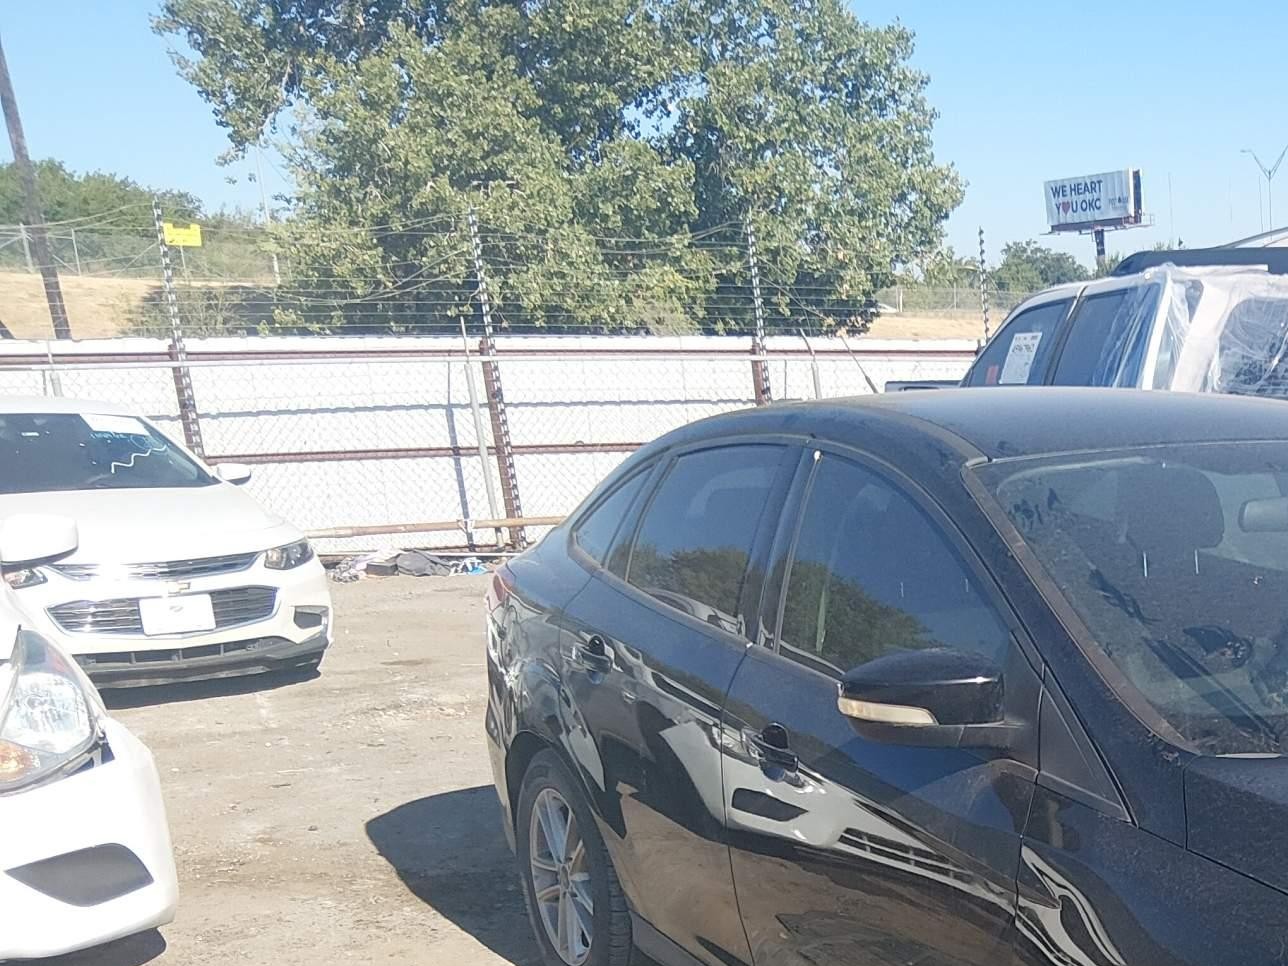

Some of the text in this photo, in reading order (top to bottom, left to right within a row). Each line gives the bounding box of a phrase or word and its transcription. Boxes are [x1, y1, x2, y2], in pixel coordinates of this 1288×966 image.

[1051, 180, 1103, 198] WE HEART
[1080, 198, 1102, 212] OKC
